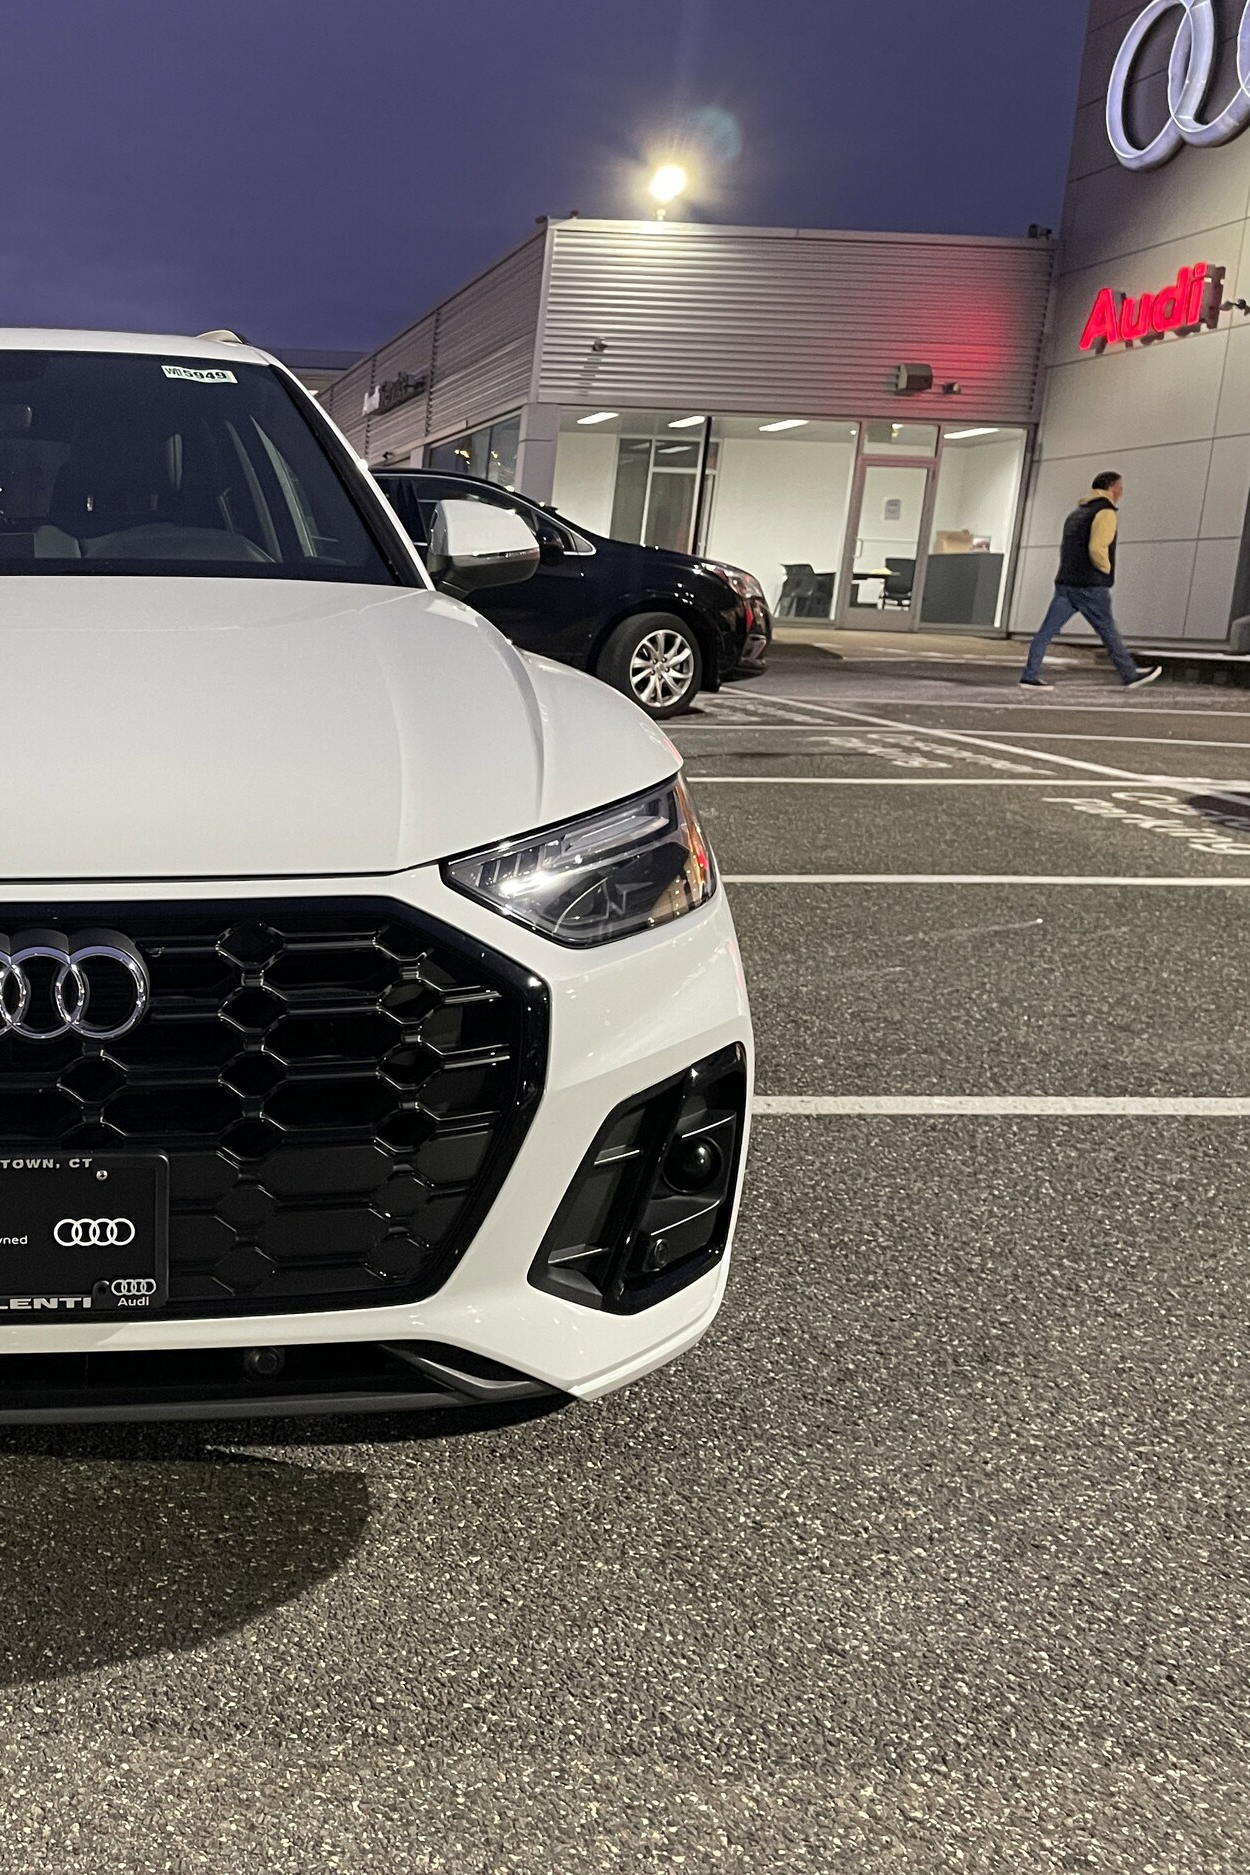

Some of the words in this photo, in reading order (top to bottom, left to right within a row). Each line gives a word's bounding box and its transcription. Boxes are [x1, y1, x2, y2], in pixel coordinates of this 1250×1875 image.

[1079, 261, 1208, 350] Audi
[68, 1158, 93, 1168] CT
[117, 1297, 150, 1307] Audi
